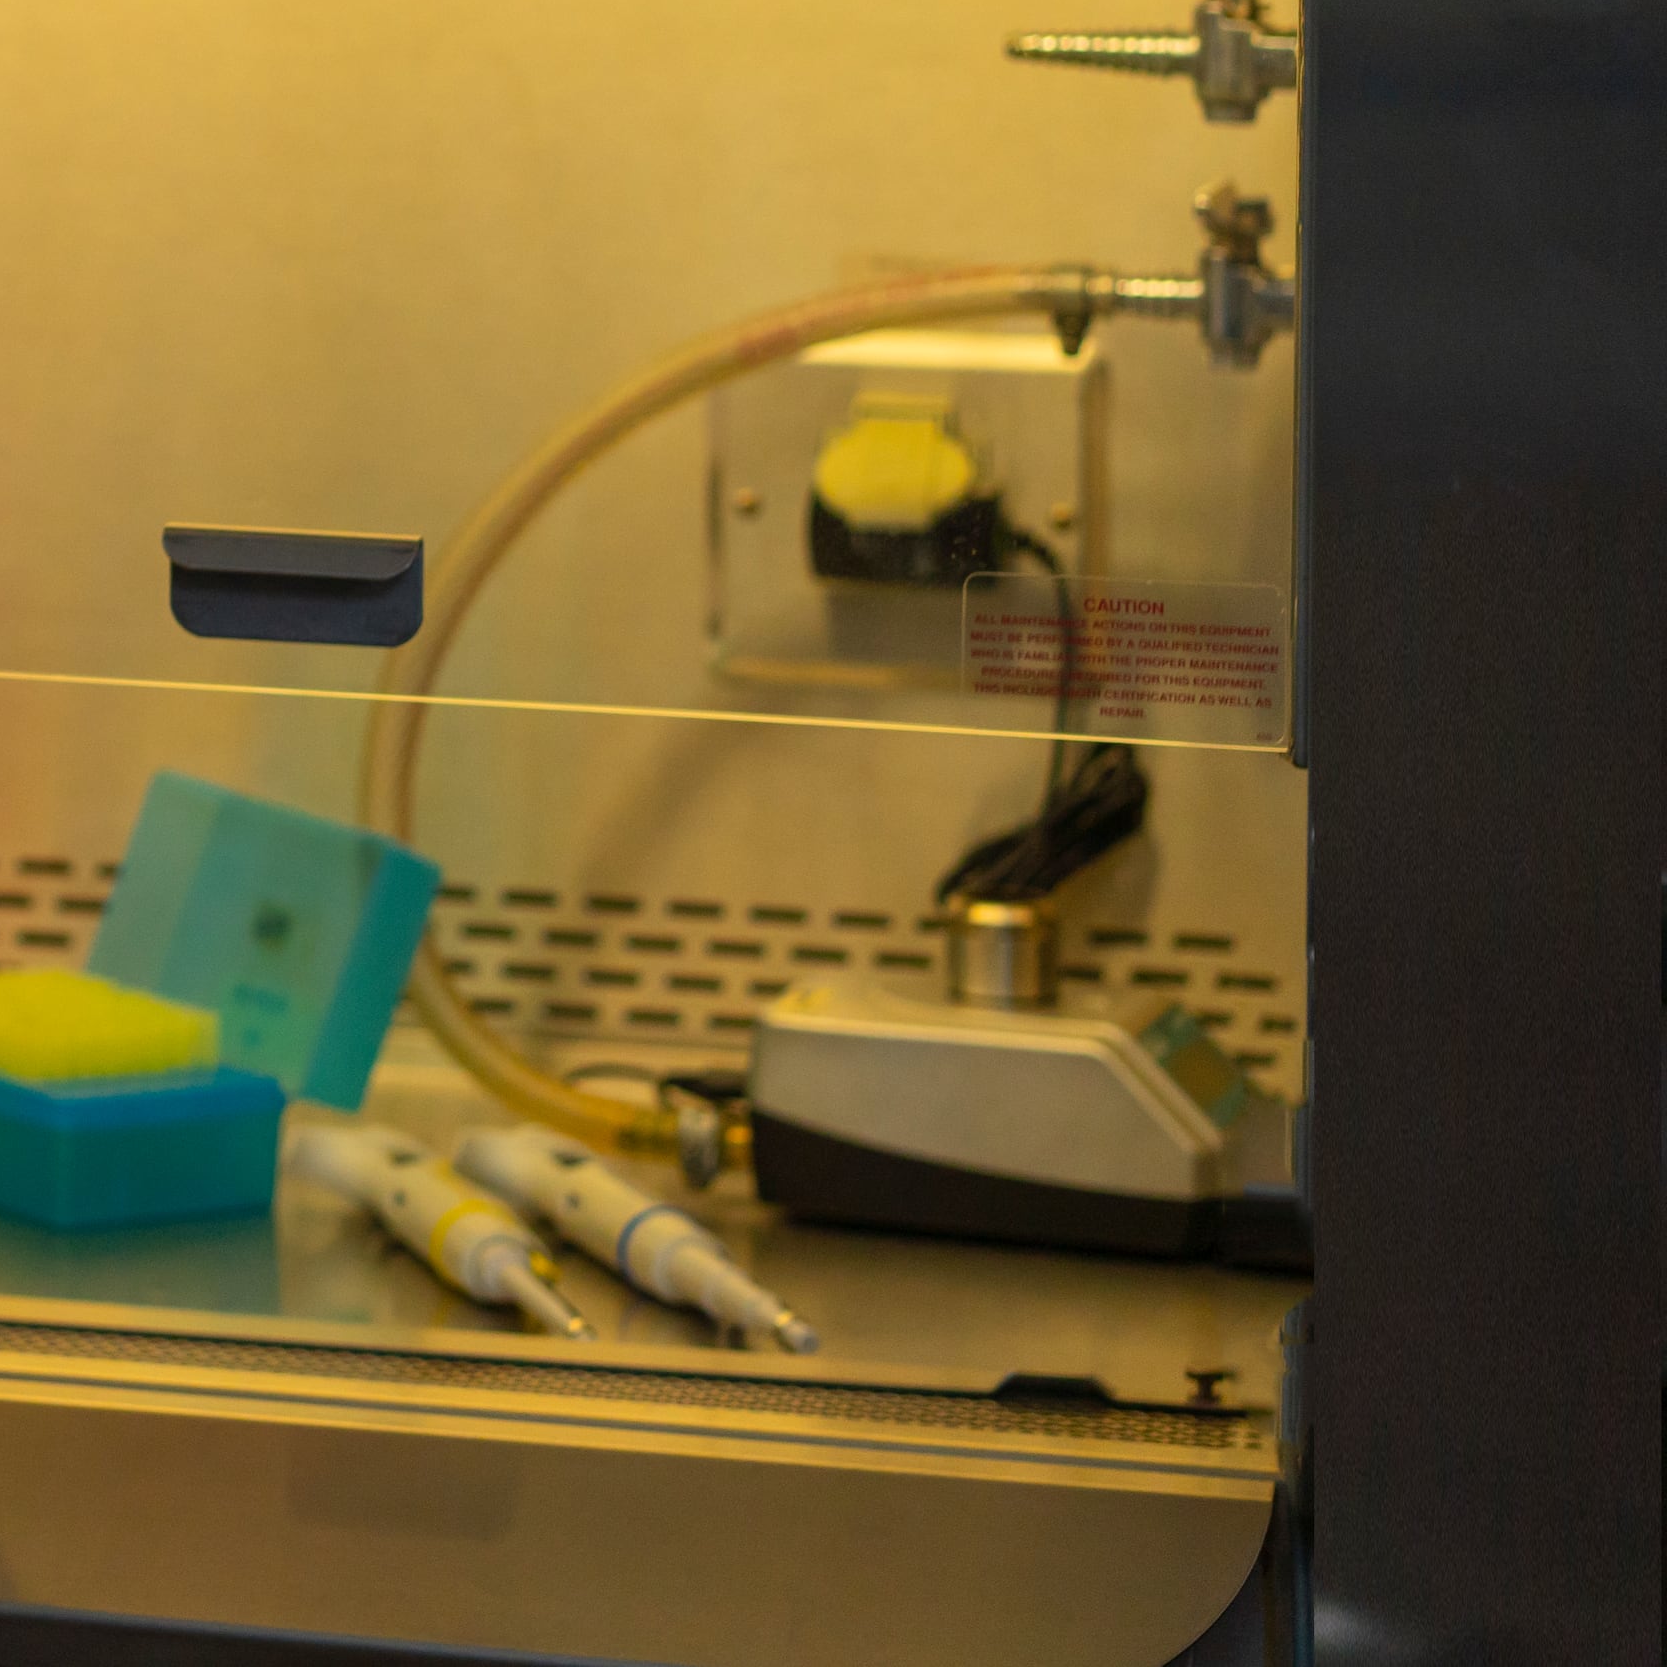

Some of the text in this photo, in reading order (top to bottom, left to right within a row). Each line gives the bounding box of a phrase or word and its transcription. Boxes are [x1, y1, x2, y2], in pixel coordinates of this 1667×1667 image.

[1083, 597, 1165, 615] CAUTION
[974, 613, 995, 625] ALL
[1092, 618, 1146, 633] ACTIONS
[1149, 622, 1167, 633] ON
[1170, 623, 1196, 635] THIS
[1199, 624, 1272, 637] EQUIPMENT
[1107, 636, 1122, 648] BY
[1126, 638, 1135, 649] A
[1138, 638, 1202, 652] QUALIFIED
[1205, 641, 1279, 656] TECHNICIAN
[1076, 653, 1106, 665] WITH
[1109, 655, 1131, 667] THE
[1135, 655, 1185, 669] PROPER
[1189, 658, 1277, 673] MAINTENANCE
[1134, 673, 1160, 685] FOR
[1162, 674, 1189, 686] THIS
[1104, 689, 1196, 704] CERTIFICATION
[1199, 693, 1215, 705] AS
[1218, 694, 1250, 707] WELL
[1255, 696, 1272, 708] AS
